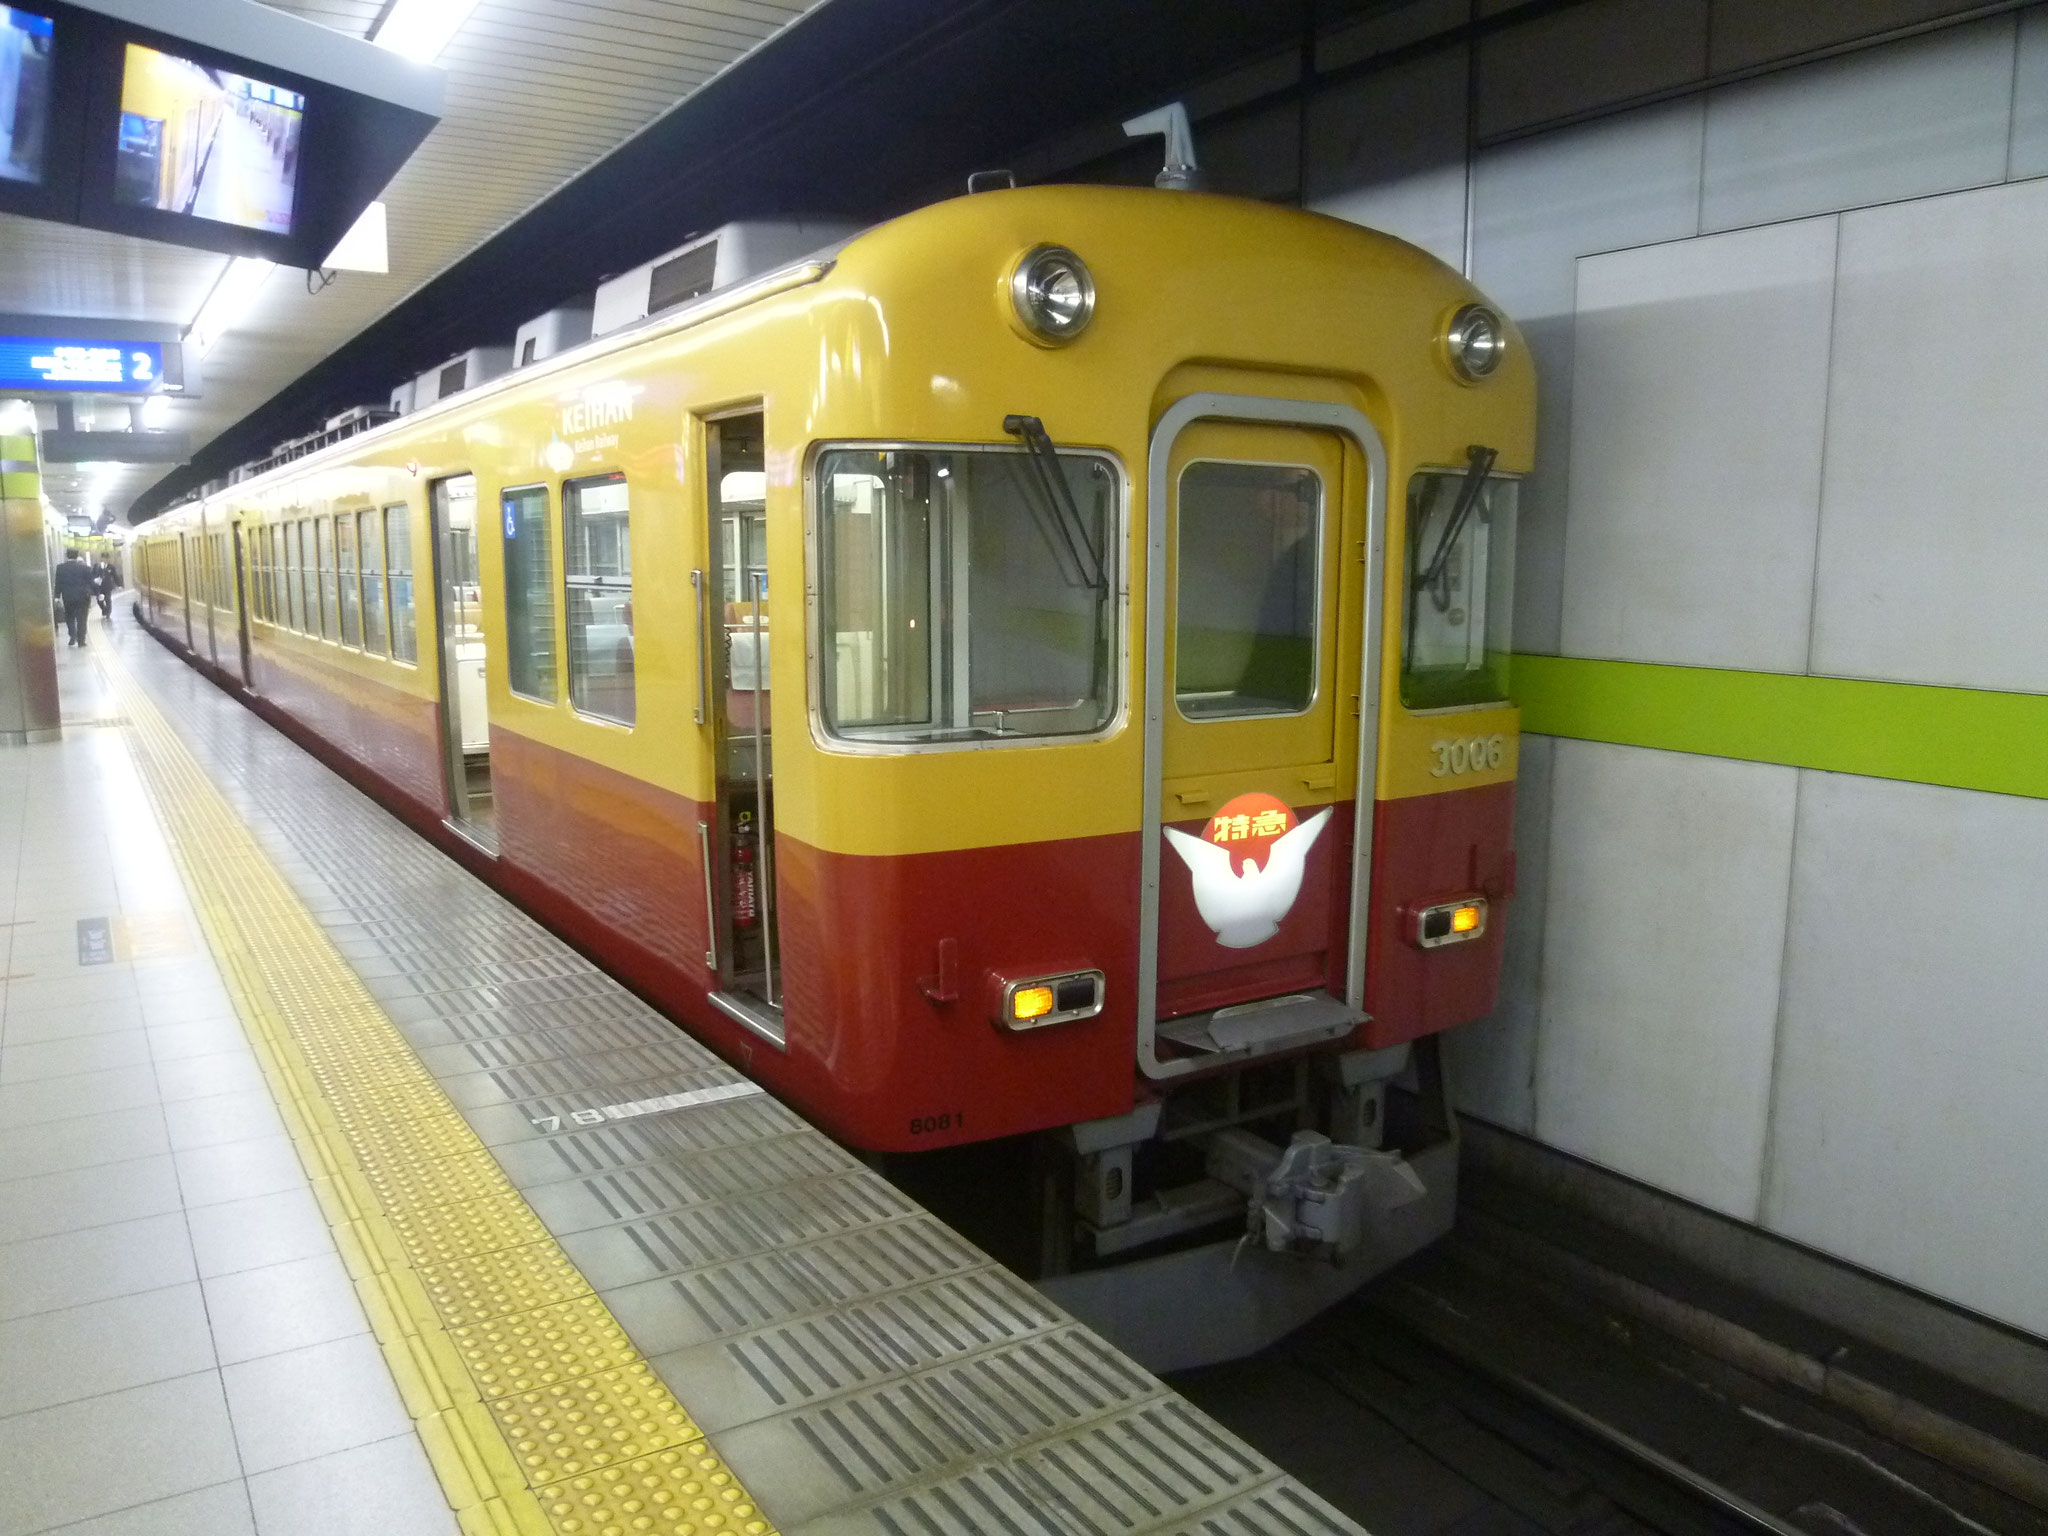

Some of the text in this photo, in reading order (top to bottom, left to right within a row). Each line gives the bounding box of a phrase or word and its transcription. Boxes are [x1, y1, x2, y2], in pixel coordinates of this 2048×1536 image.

[132, 352, 153, 380] 2
[562, 394, 633, 436] KEIHAN
[1431, 734, 1503, 777] 3006
[1213, 810, 1287, 843] 特急
[910, 1112, 963, 1135] 8081
